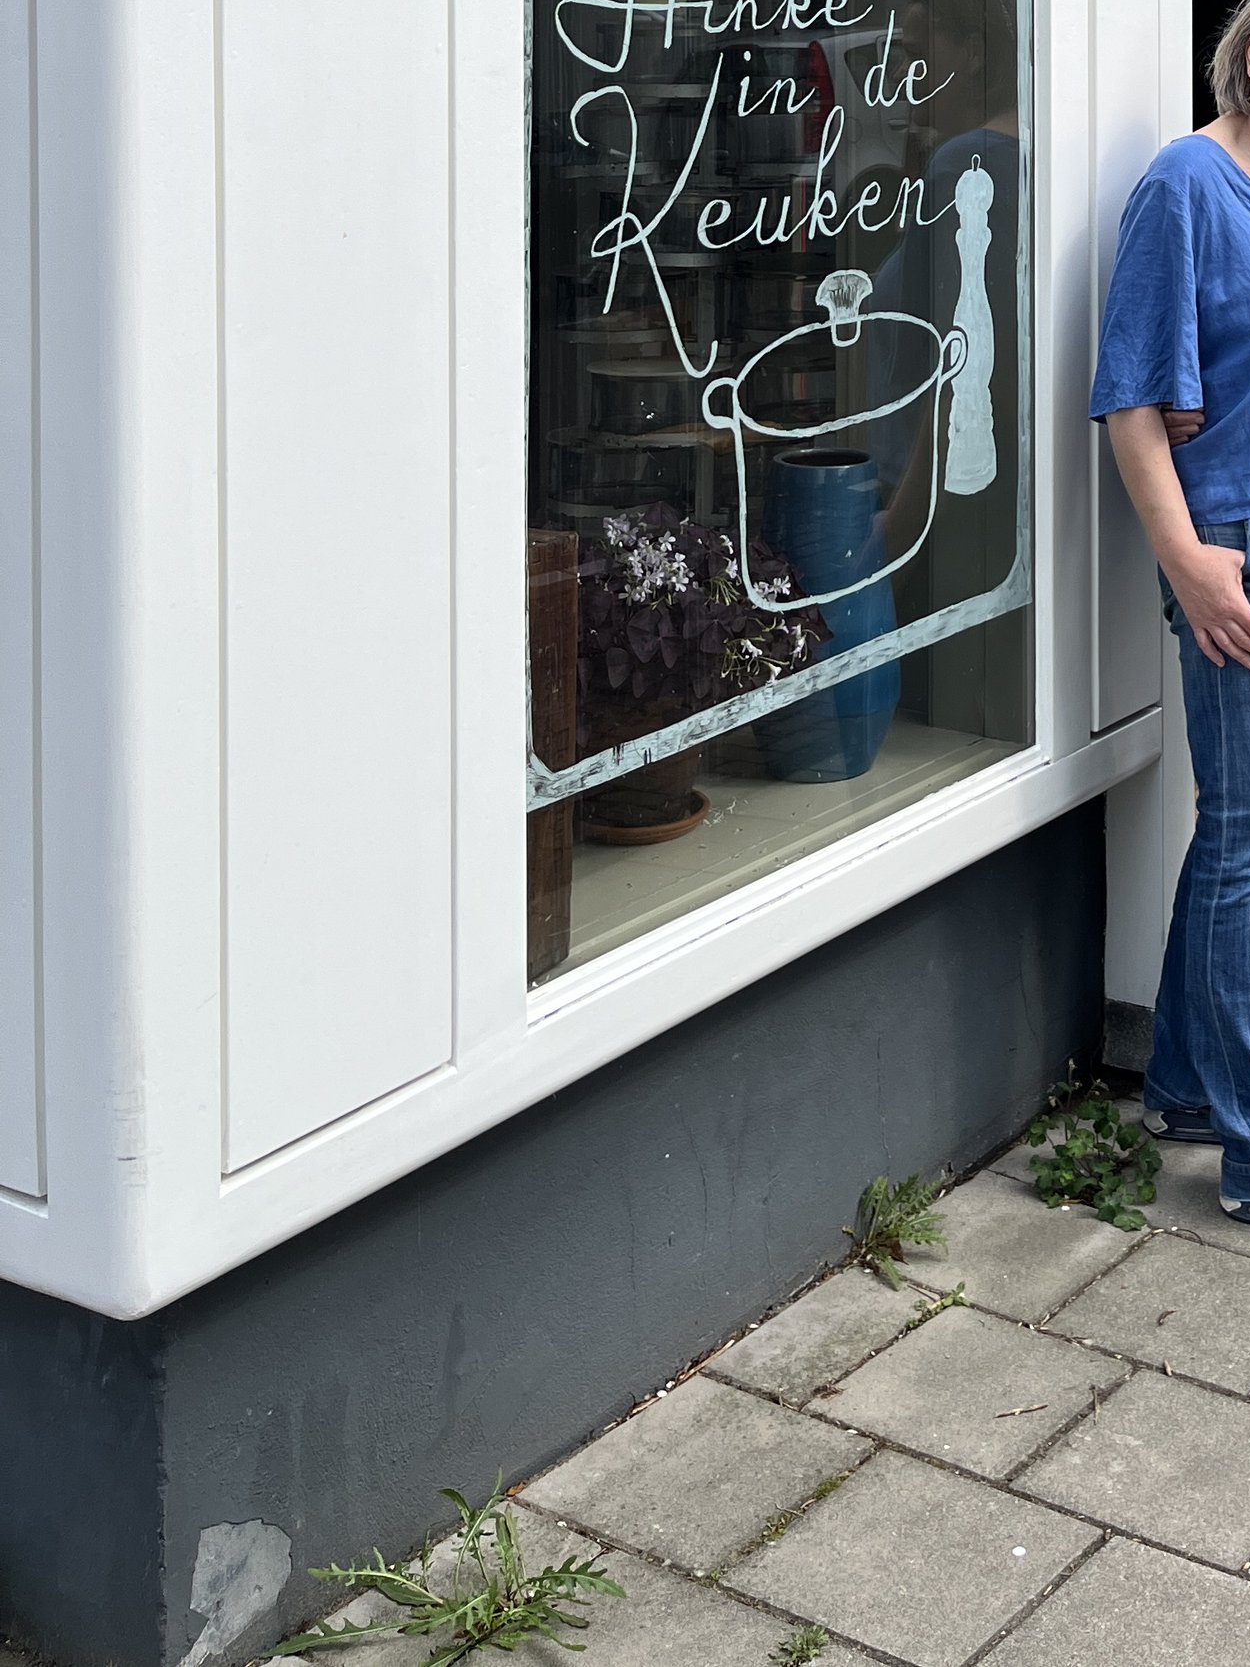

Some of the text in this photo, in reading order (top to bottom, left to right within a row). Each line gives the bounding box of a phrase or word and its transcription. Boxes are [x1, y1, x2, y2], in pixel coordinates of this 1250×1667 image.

[736, 9, 956, 118] in de
[569, 51, 958, 379] Keuken
